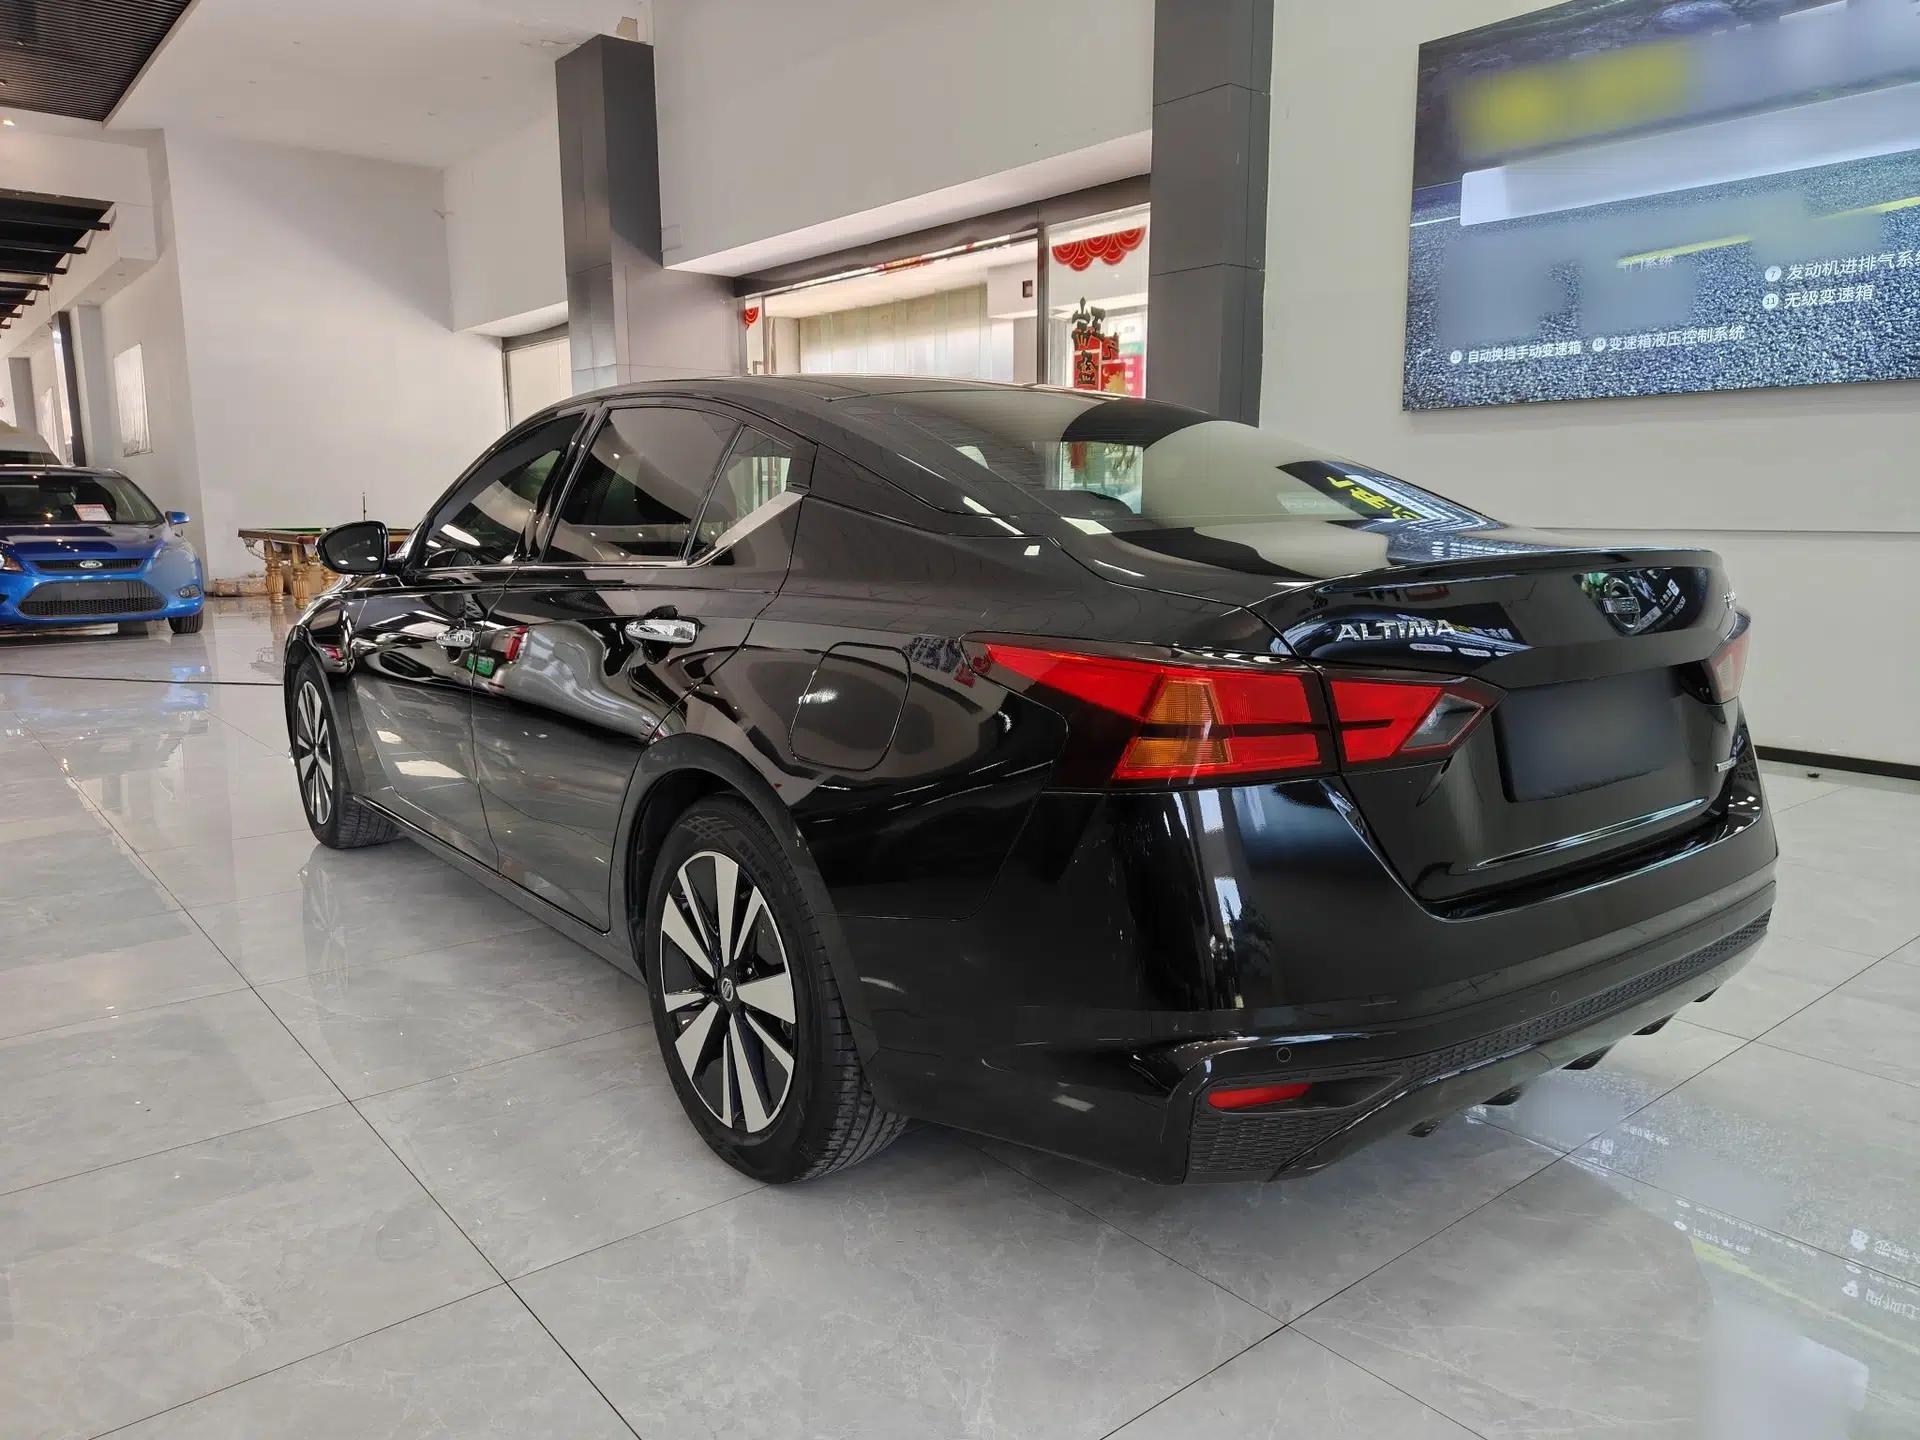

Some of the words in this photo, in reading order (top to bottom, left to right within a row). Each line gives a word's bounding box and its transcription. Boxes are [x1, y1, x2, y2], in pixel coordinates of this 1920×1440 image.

[1784, 283, 1875, 309] 无级变速箱
[1608, 324, 1746, 352] 变速箱液压控制系统
[1468, 340, 1582, 364] 自动换挡手动变速箱
[1335, 619, 1456, 642] ALTIMA
